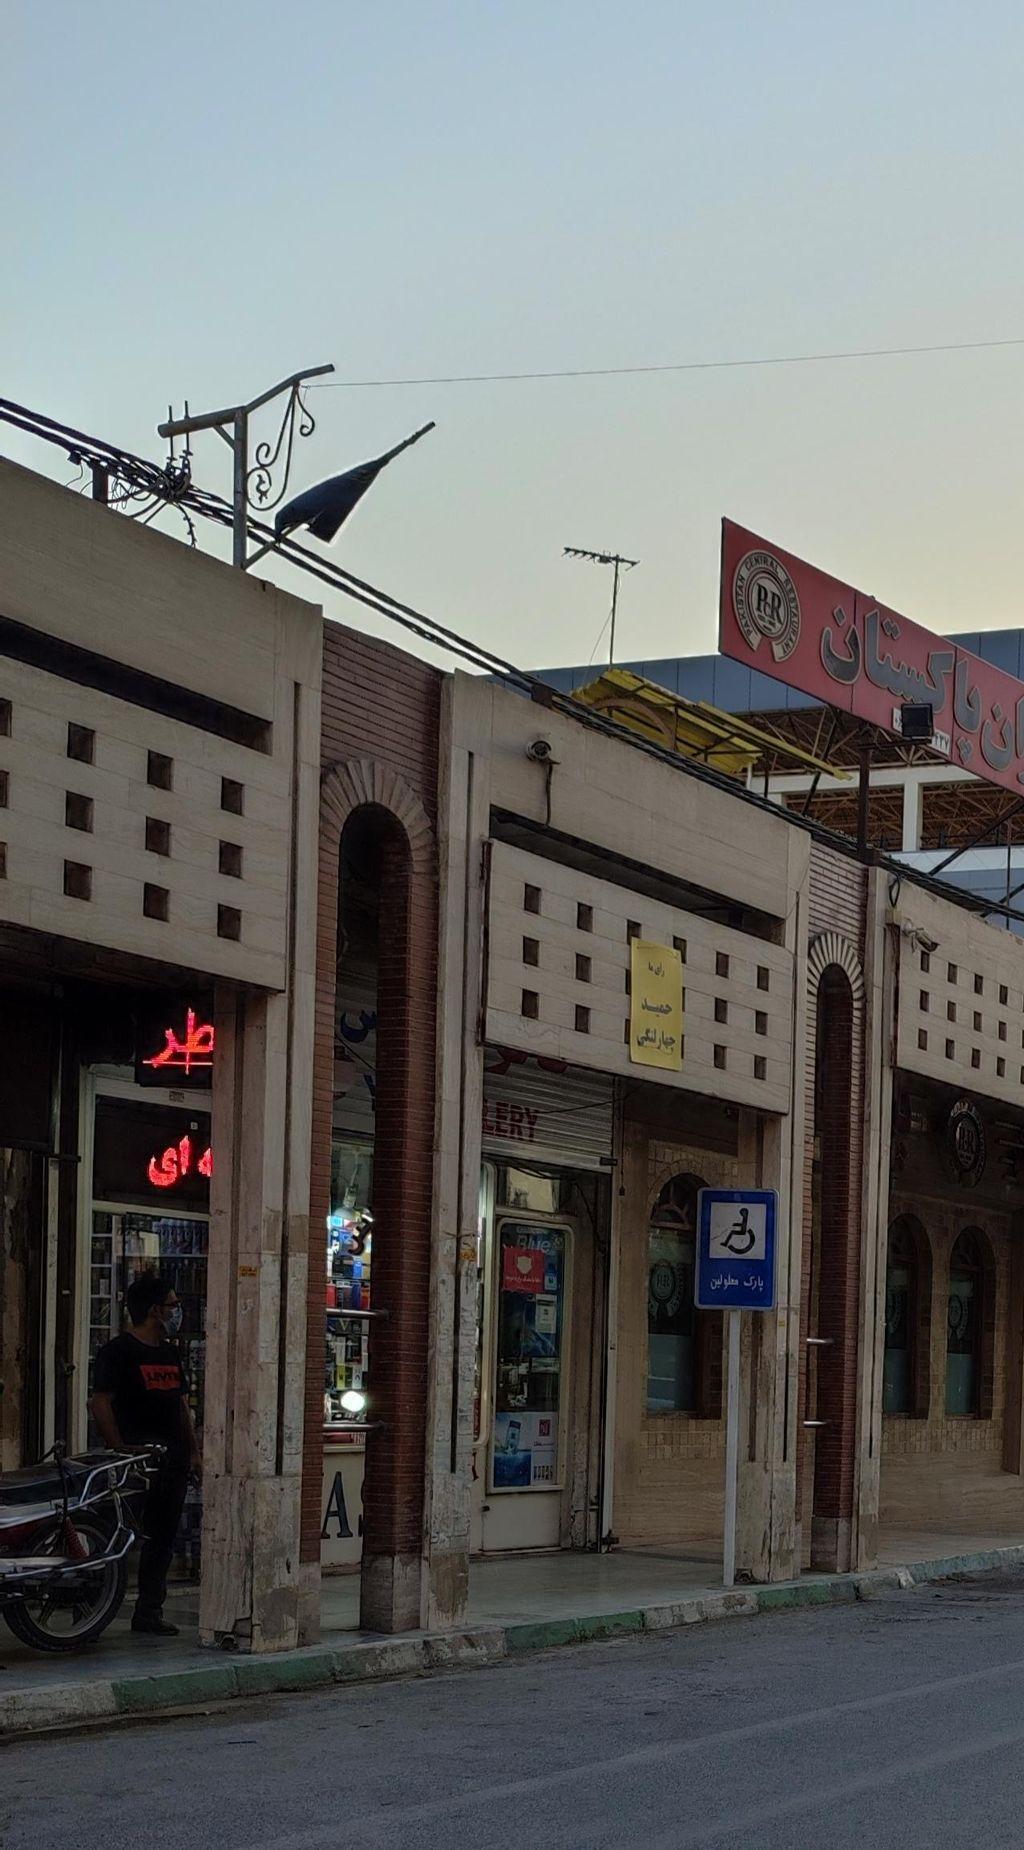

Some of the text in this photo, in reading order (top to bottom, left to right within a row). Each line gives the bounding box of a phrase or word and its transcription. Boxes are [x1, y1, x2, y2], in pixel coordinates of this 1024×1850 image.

[745, 555, 779, 575] CENTRAL
[820, 605, 982, 765] پاکستان
[711, 1273, 764, 1292] پارک معلولین
